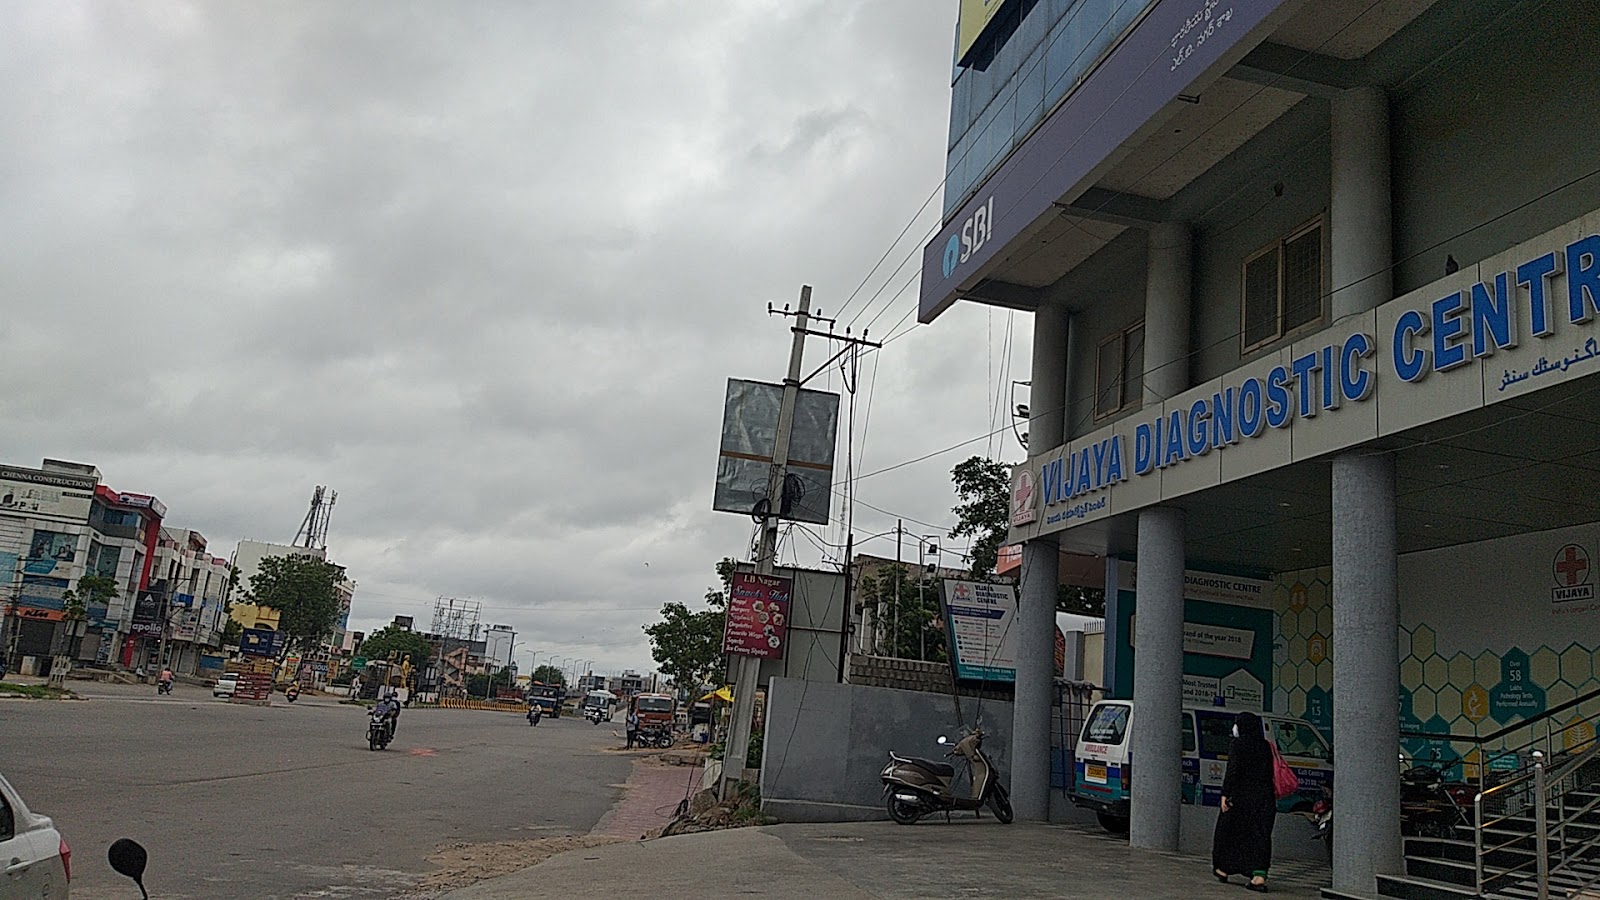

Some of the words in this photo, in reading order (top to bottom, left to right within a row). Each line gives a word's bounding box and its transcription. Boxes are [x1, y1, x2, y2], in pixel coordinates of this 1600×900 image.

[960, 195, 993, 264] SBI
[1041, 434, 1126, 506] VIJAYA
[1134, 332, 1376, 476] DIAGNOSTIC
[2, 471, 32, 481] CHENNA
[33, 475, 93, 489] CONSTRUCTIONS
[1013, 513, 1031, 523] VIJAYA
[744, 574, 756, 583] LB
[758, 576, 781, 587] Nagar
[1184, 576, 1231, 590] DIAGNOSTIC
[1233, 583, 1261, 594] CENTRE
[975, 591, 1009, 600] DIAGNOSTIC
[1556, 587, 1590, 599] VIJAYA
[977, 597, 998, 605] CENTRE
[24, 609, 49, 618] KTM
[132, 623, 162, 632] apollo
[1509, 669, 1522, 682] 58
